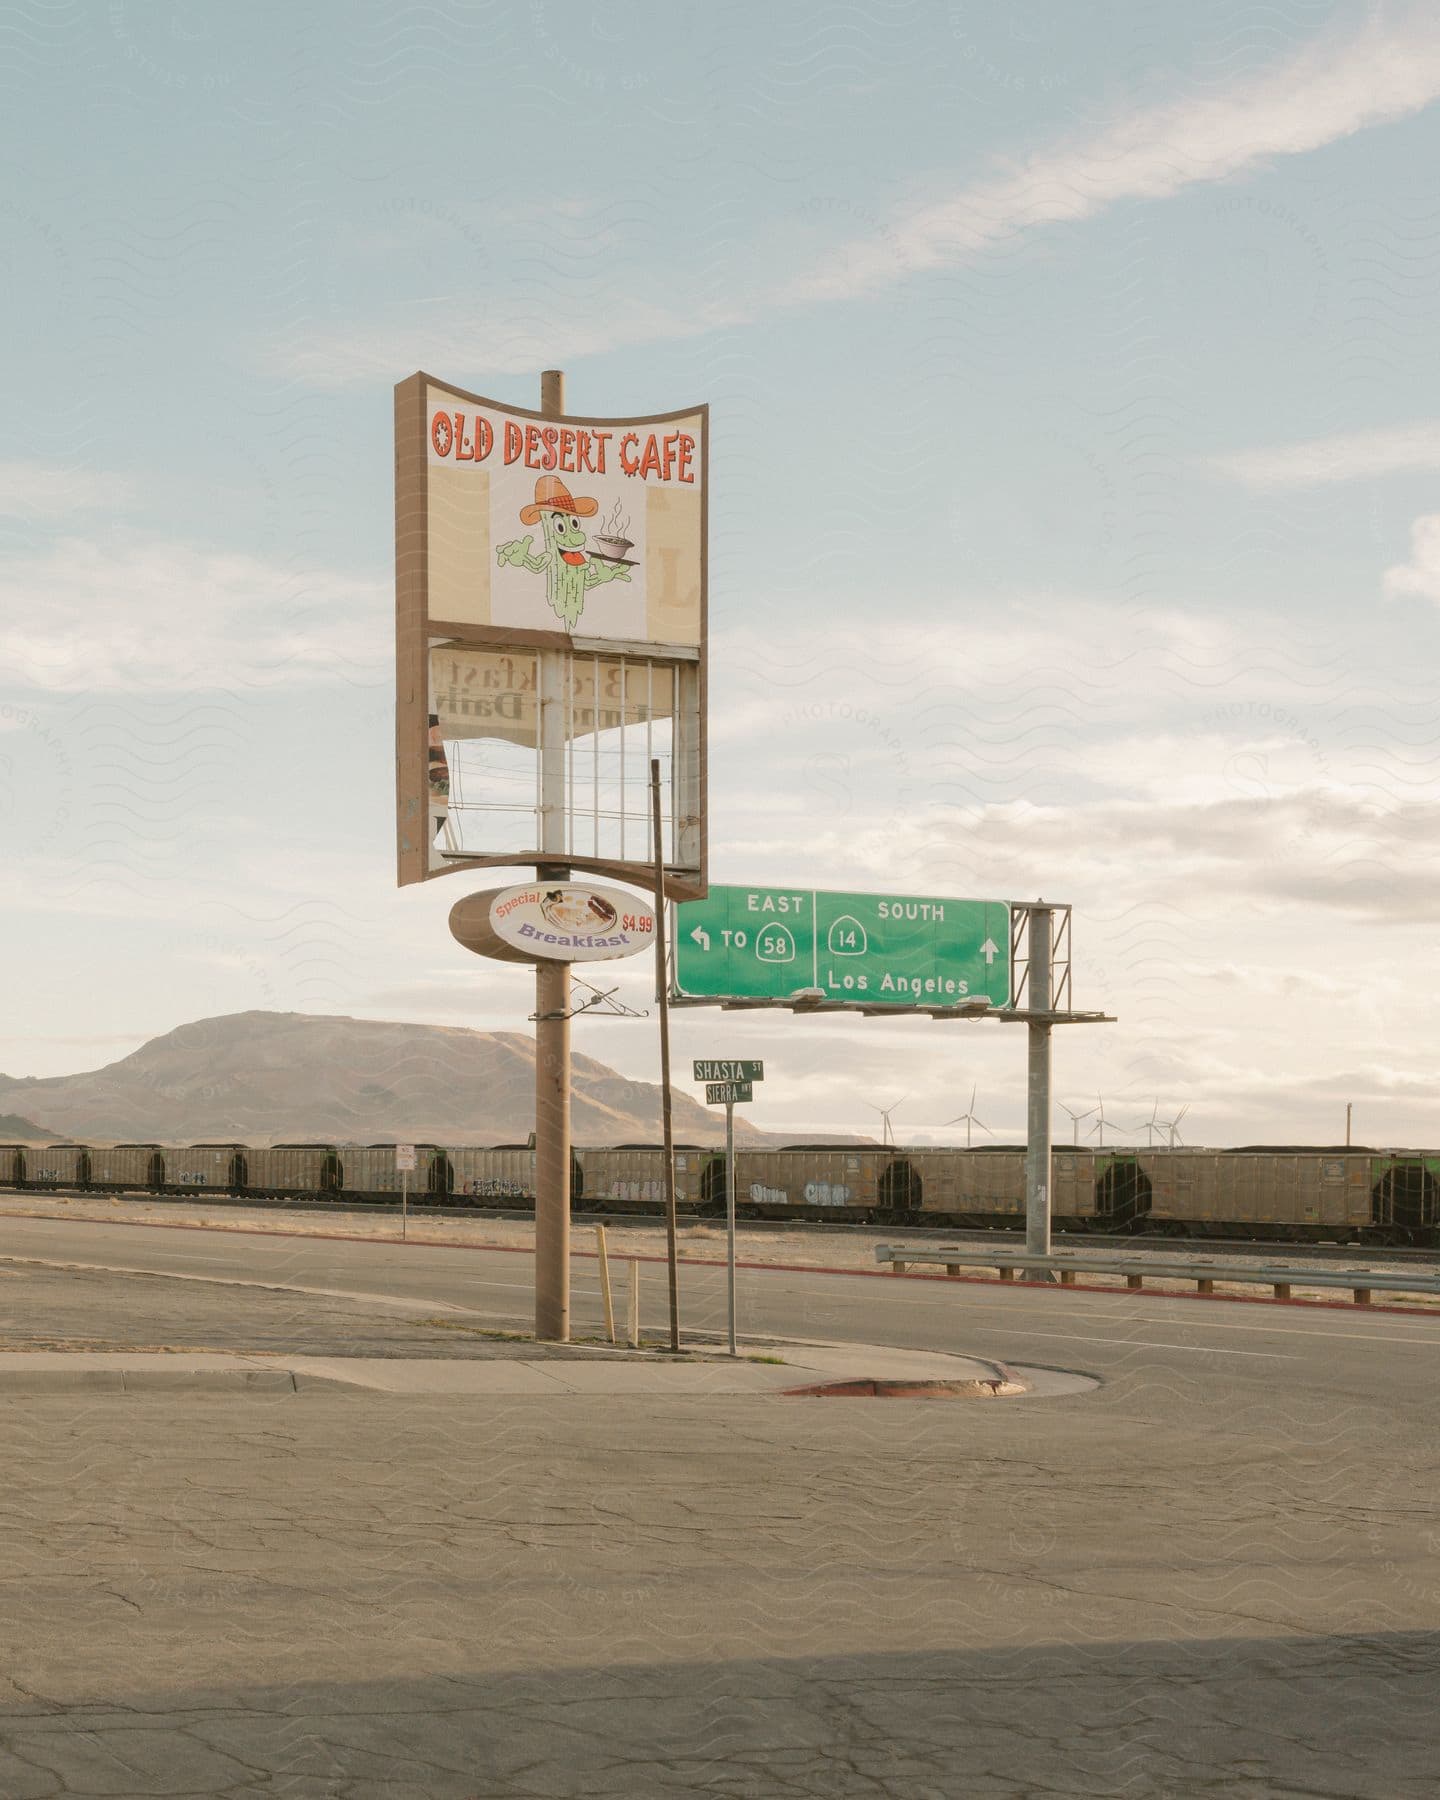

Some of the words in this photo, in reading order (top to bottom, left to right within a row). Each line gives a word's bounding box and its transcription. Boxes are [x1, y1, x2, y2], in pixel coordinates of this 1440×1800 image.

[431, 410, 494, 463] OLD
[503, 420, 613, 475] DESERT
[618, 429, 696, 484] CAFE
[496, 891, 541, 919] Special
[747, 894, 803, 914] EAST
[877, 902, 946, 922] SOUTH
[622, 914, 653, 933] $4.99
[517, 922, 631, 949] Breakfast
[721, 930, 747, 948] TO
[838, 930, 857, 948] 14
[763, 936, 787, 956] 58
[828, 970, 868, 990] Los
[880, 973, 969, 998] Angeles
[695, 1062, 745, 1080] SHASTA
[752, 1062, 761, 1072] ST
[706, 1084, 738, 1103] SIERRA
